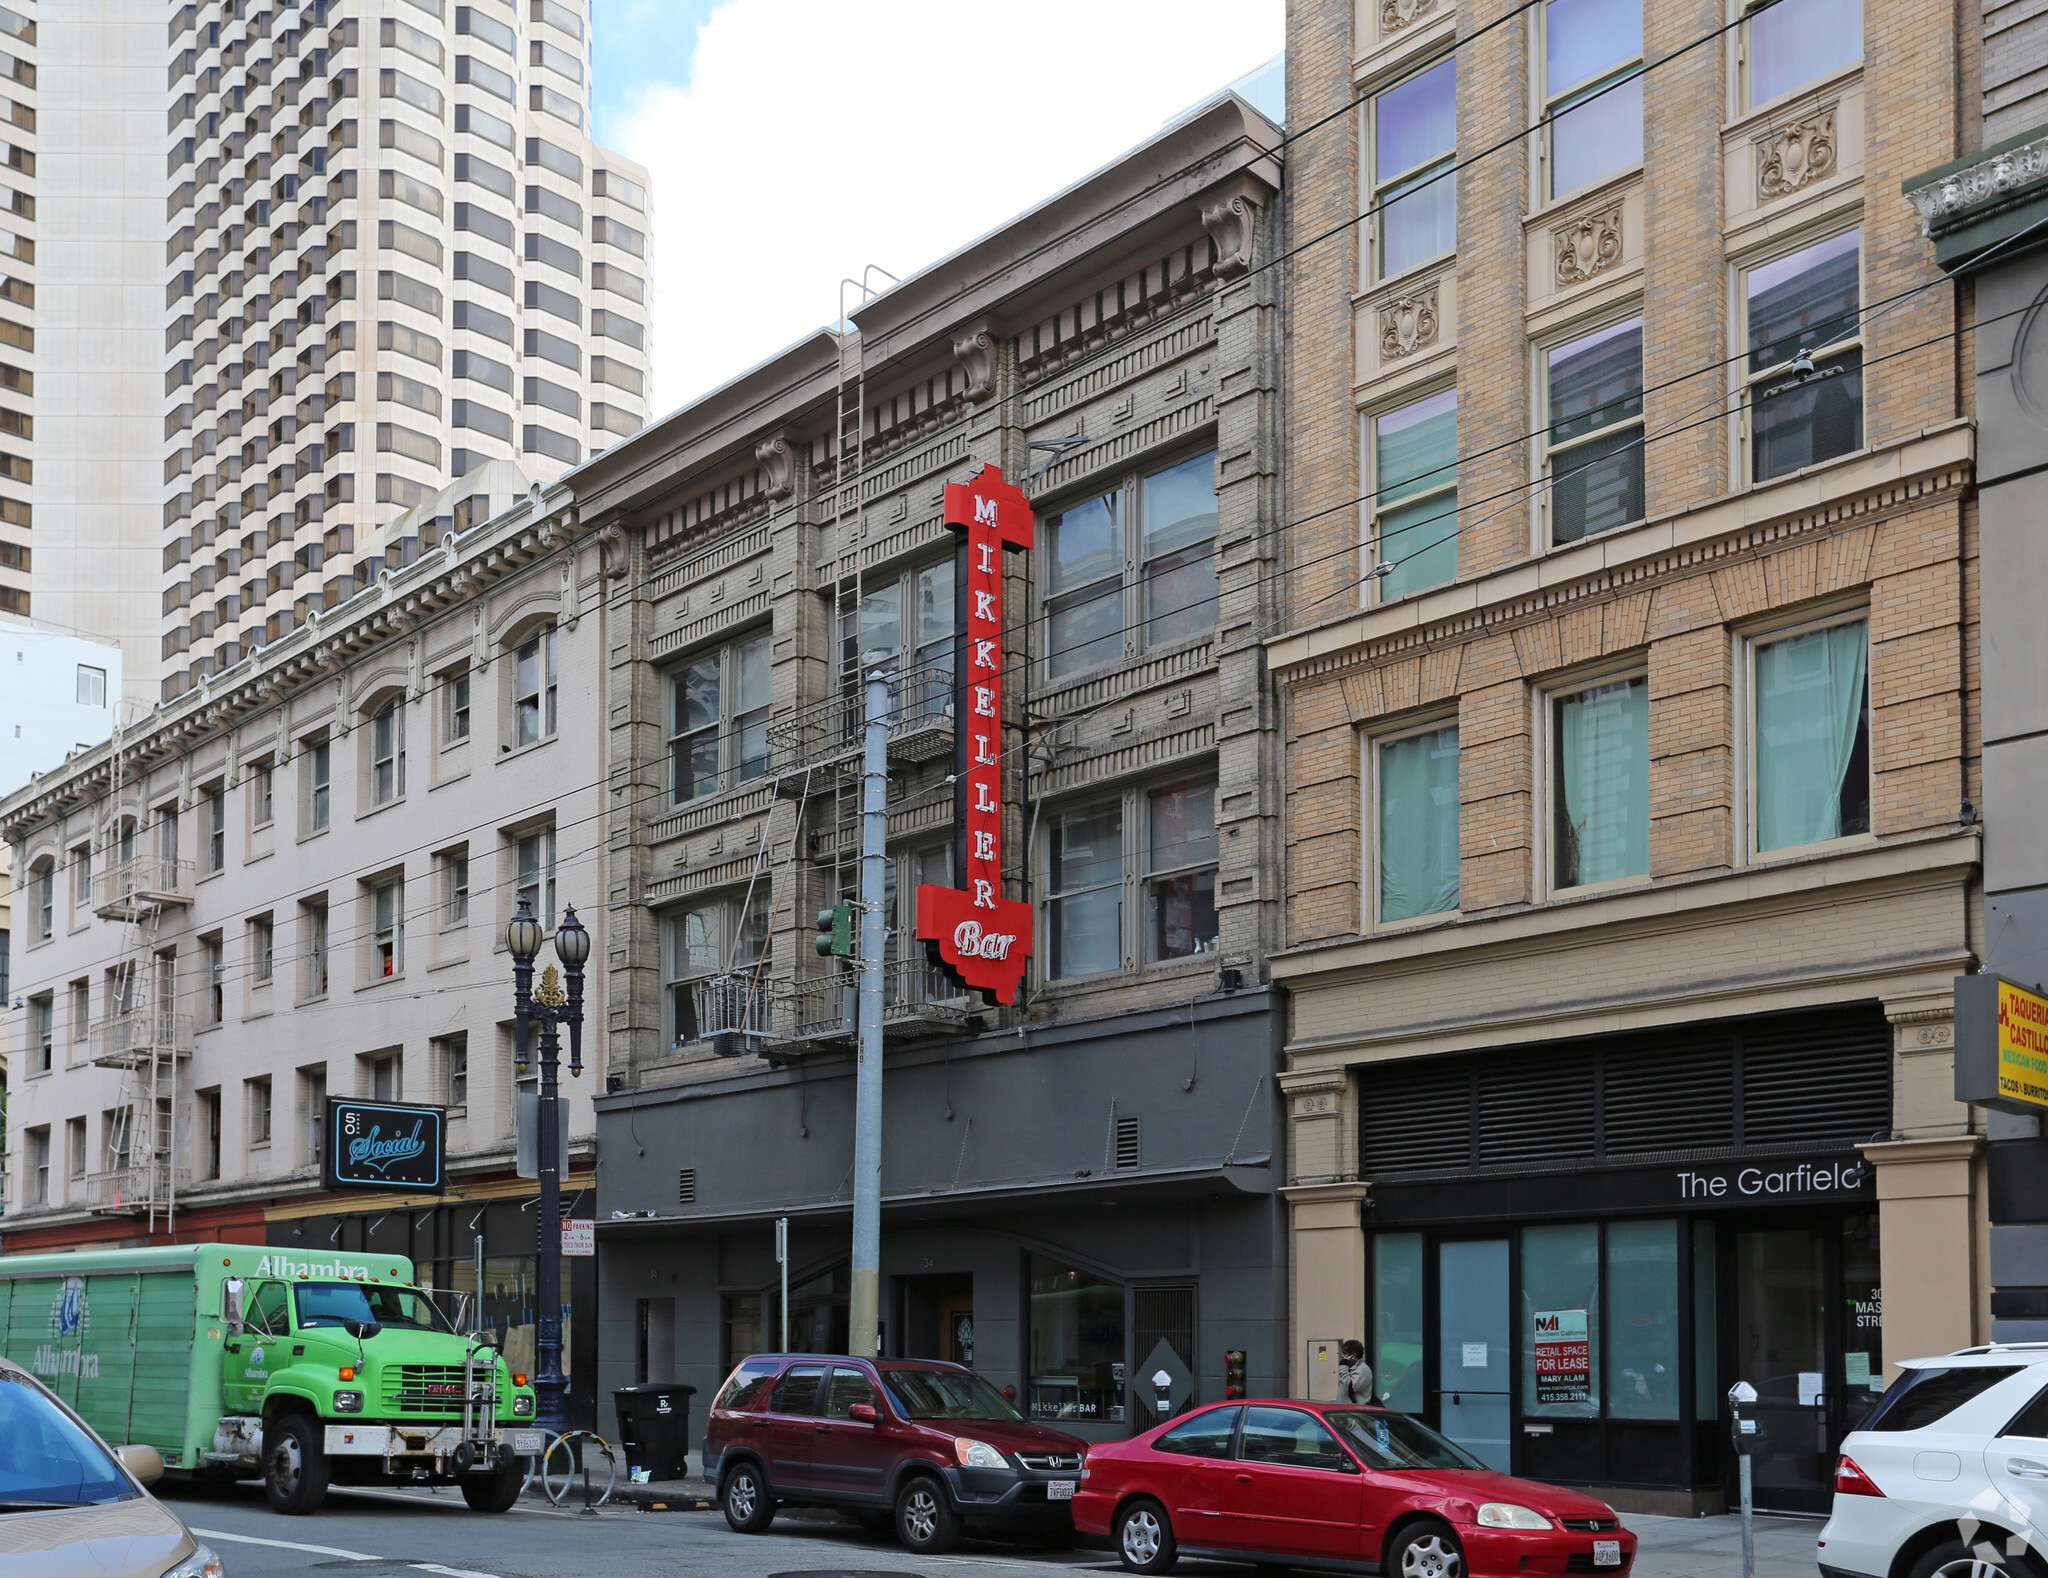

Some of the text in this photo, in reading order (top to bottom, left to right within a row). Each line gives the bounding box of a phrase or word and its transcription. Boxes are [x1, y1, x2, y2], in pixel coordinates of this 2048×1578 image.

[974, 494, 998, 910] MIKKELLER
[954, 920, 1016, 960] Bar
[2003, 1048, 2047, 1074] MEXICAN FOOD
[2000, 1077, 2048, 1101] TACOS BURRITO
[349, 1119, 425, 1166] Social
[353, 1173, 421, 1182] HOUSE
[1677, 1161, 1861, 1198] The Garfield
[562, 1221, 571, 1230] NO
[253, 1255, 369, 1279] Alhambra
[1856, 1301, 1882, 1313] MAS
[1536, 1314, 1558, 1331] NAI
[1856, 1315, 1883, 1327] STRE
[1536, 1346, 1587, 1357] RETAIL SPACE
[31, 1344, 99, 1379] Alhambra
[1536, 1357, 1588, 1371] FOR LEASE
[1541, 1374, 1585, 1383] MARY ALAM
[428, 1384, 464, 1394] GMC
[1541, 1393, 1586, 1401] 415.358.2111
[1079, 1403, 1097, 1413] BAR
